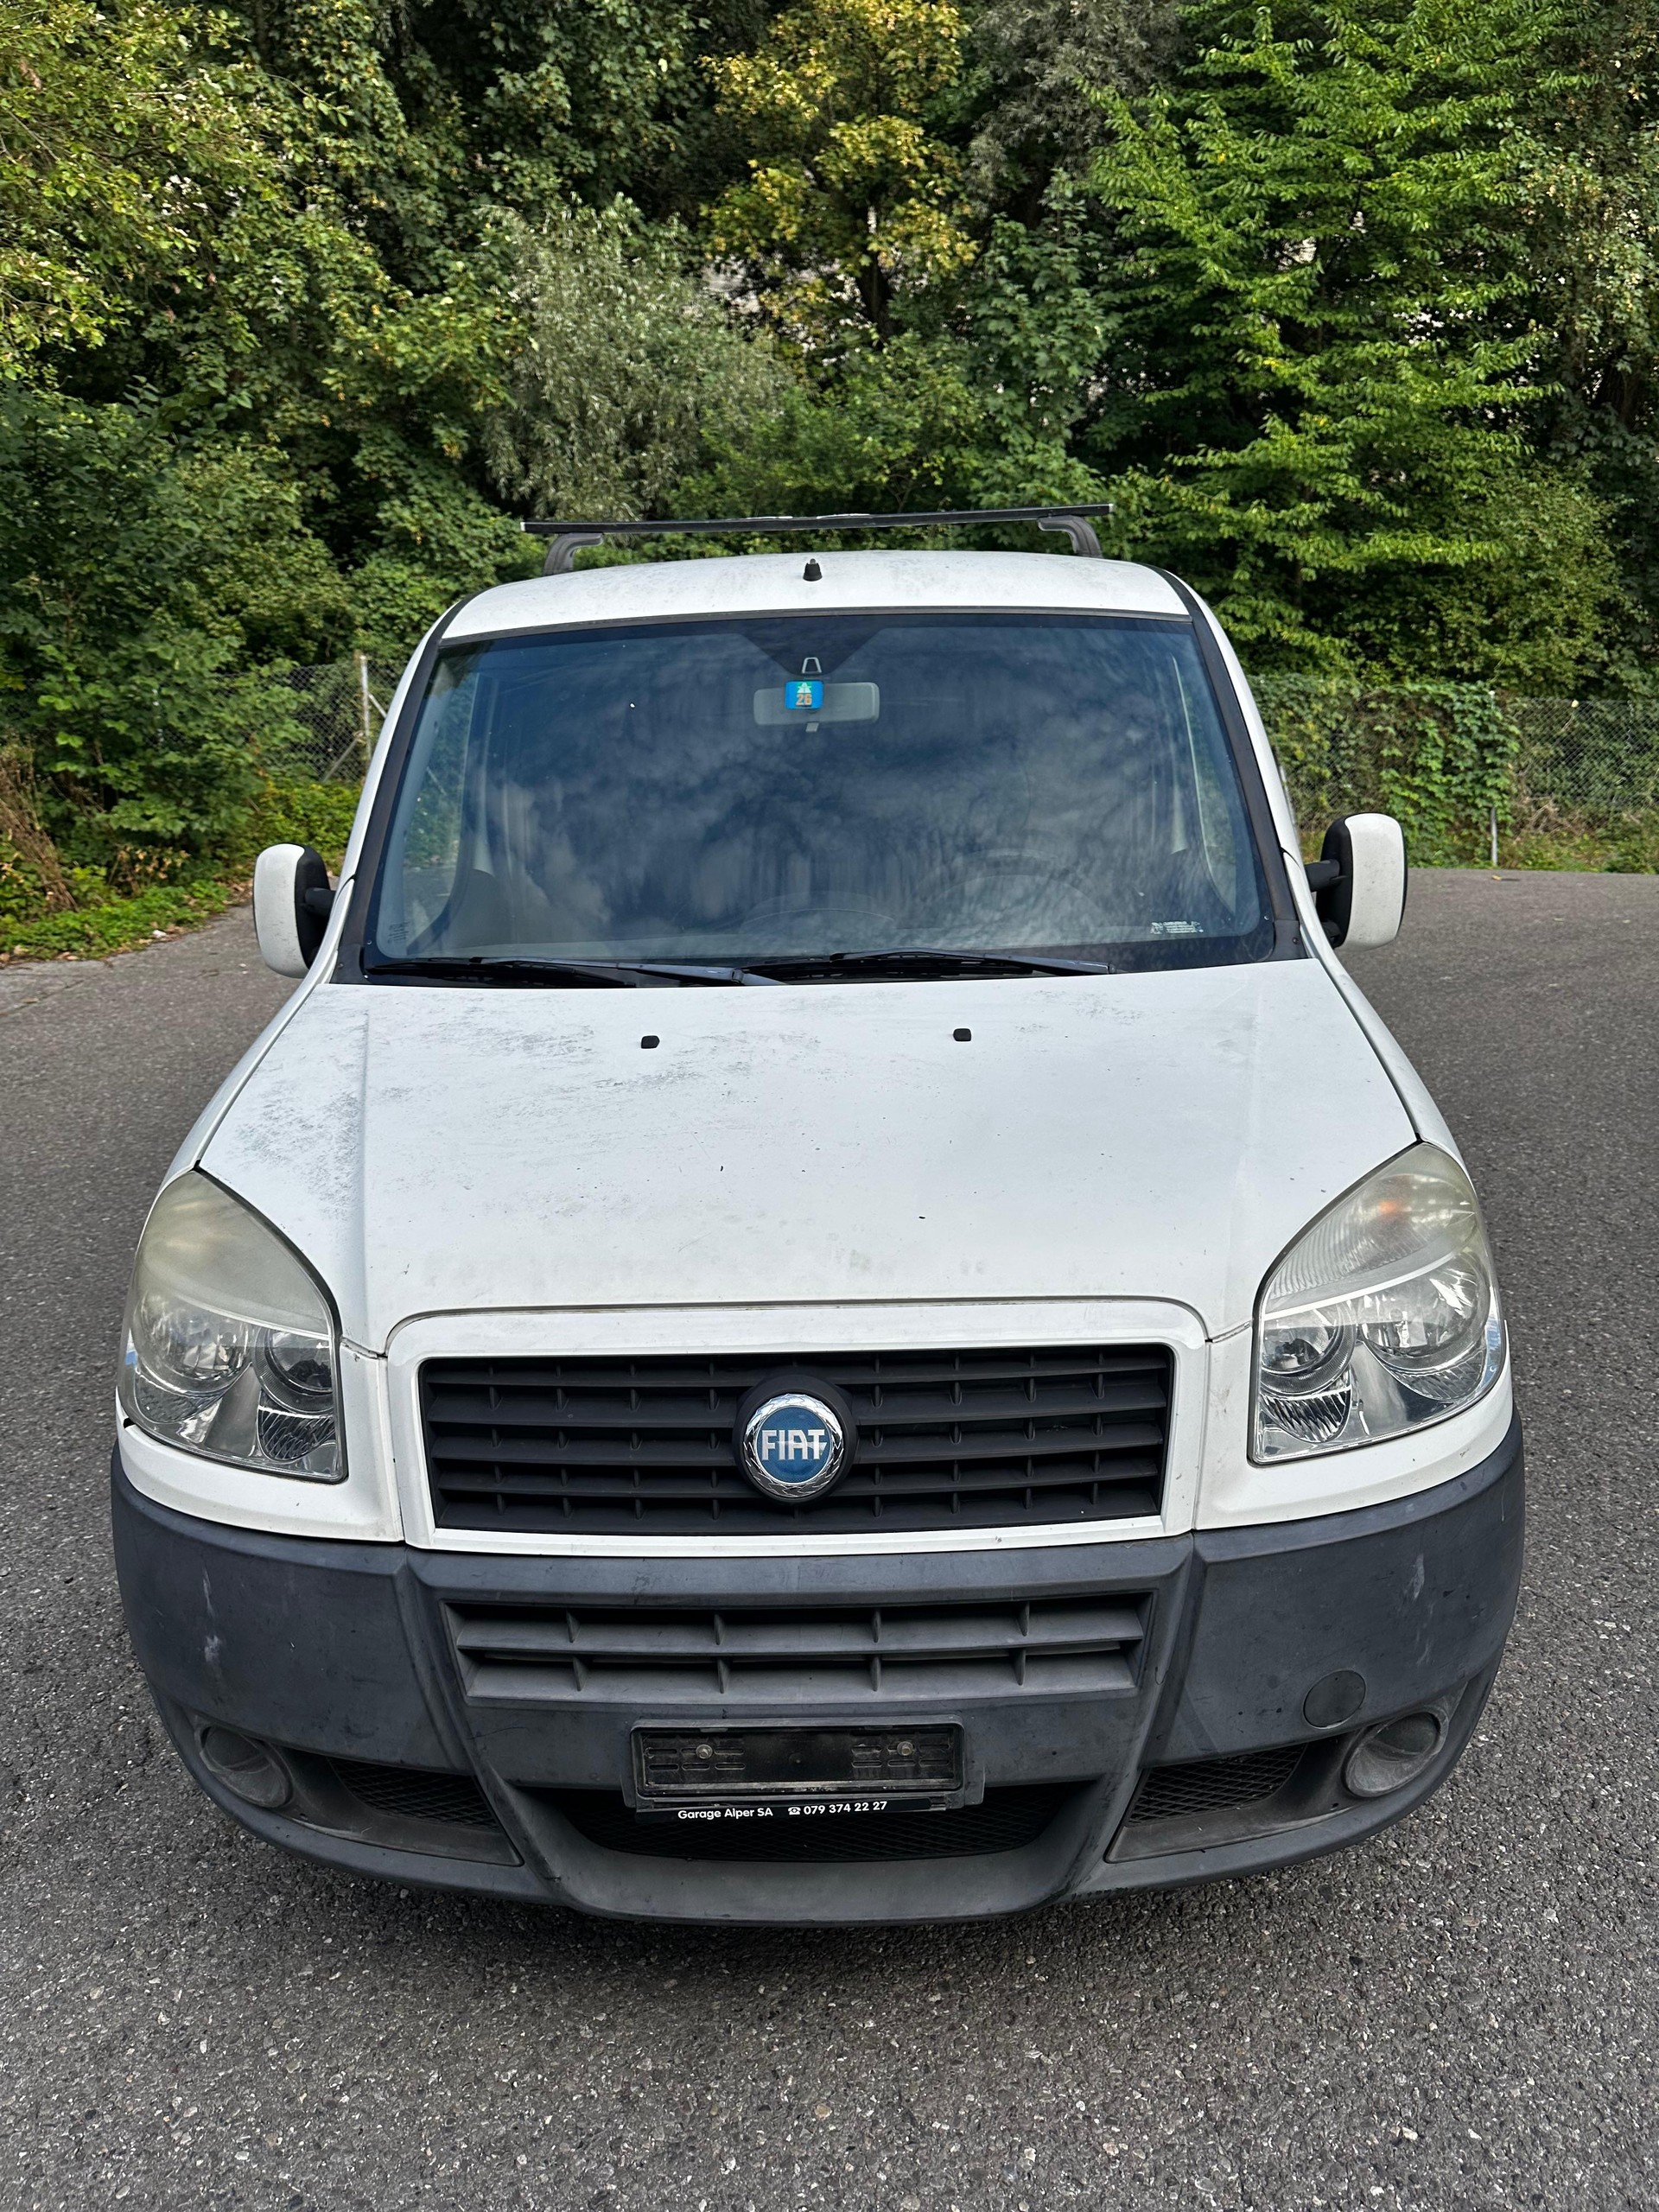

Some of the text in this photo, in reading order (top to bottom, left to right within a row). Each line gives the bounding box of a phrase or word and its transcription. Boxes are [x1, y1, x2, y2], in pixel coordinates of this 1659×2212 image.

[796, 693, 812, 706] 26
[761, 1429, 825, 1460] FIAT
[677, 1801, 887, 1820] Garage Alper SA 079 374 22 27
